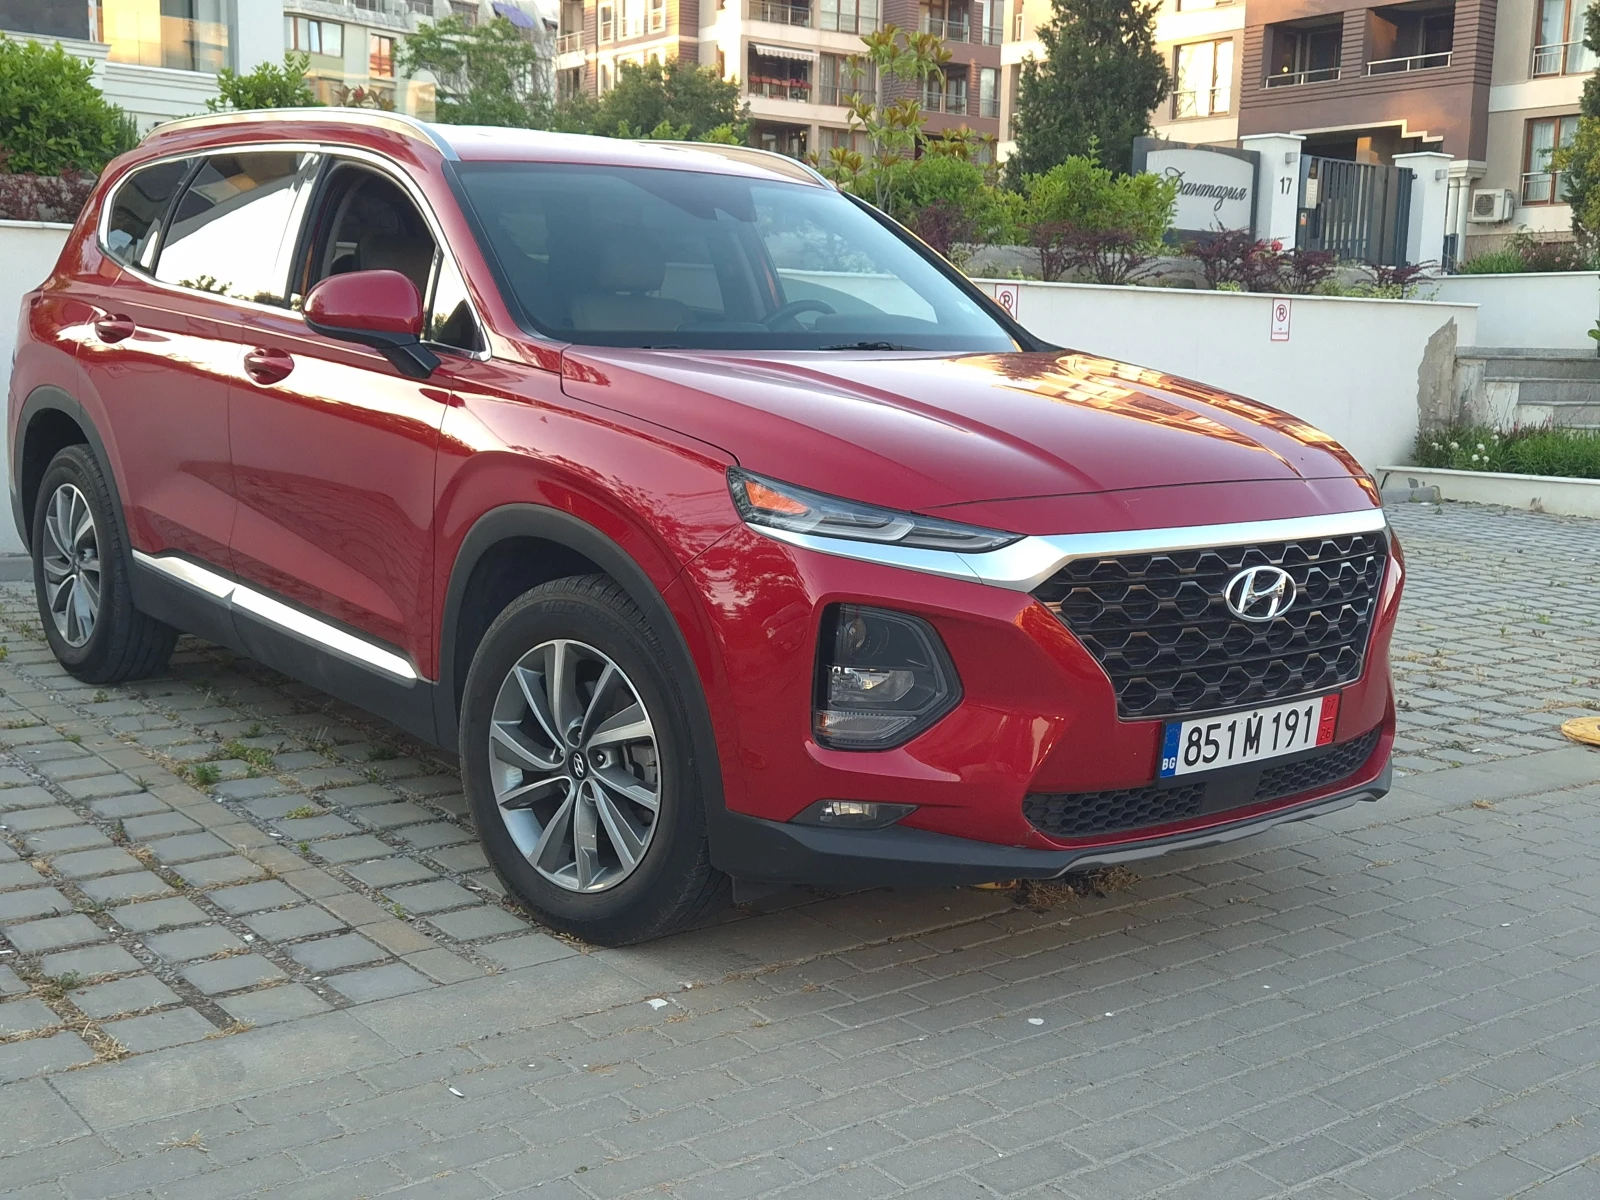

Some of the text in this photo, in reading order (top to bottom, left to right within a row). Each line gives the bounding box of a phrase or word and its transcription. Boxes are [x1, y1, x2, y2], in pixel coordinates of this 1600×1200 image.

[1279, 176, 1293, 195] 17
[1183, 705, 1314, 767] 851 M 191
[1319, 726, 1331, 740] 26
[1161, 756, 1176, 771] BG
